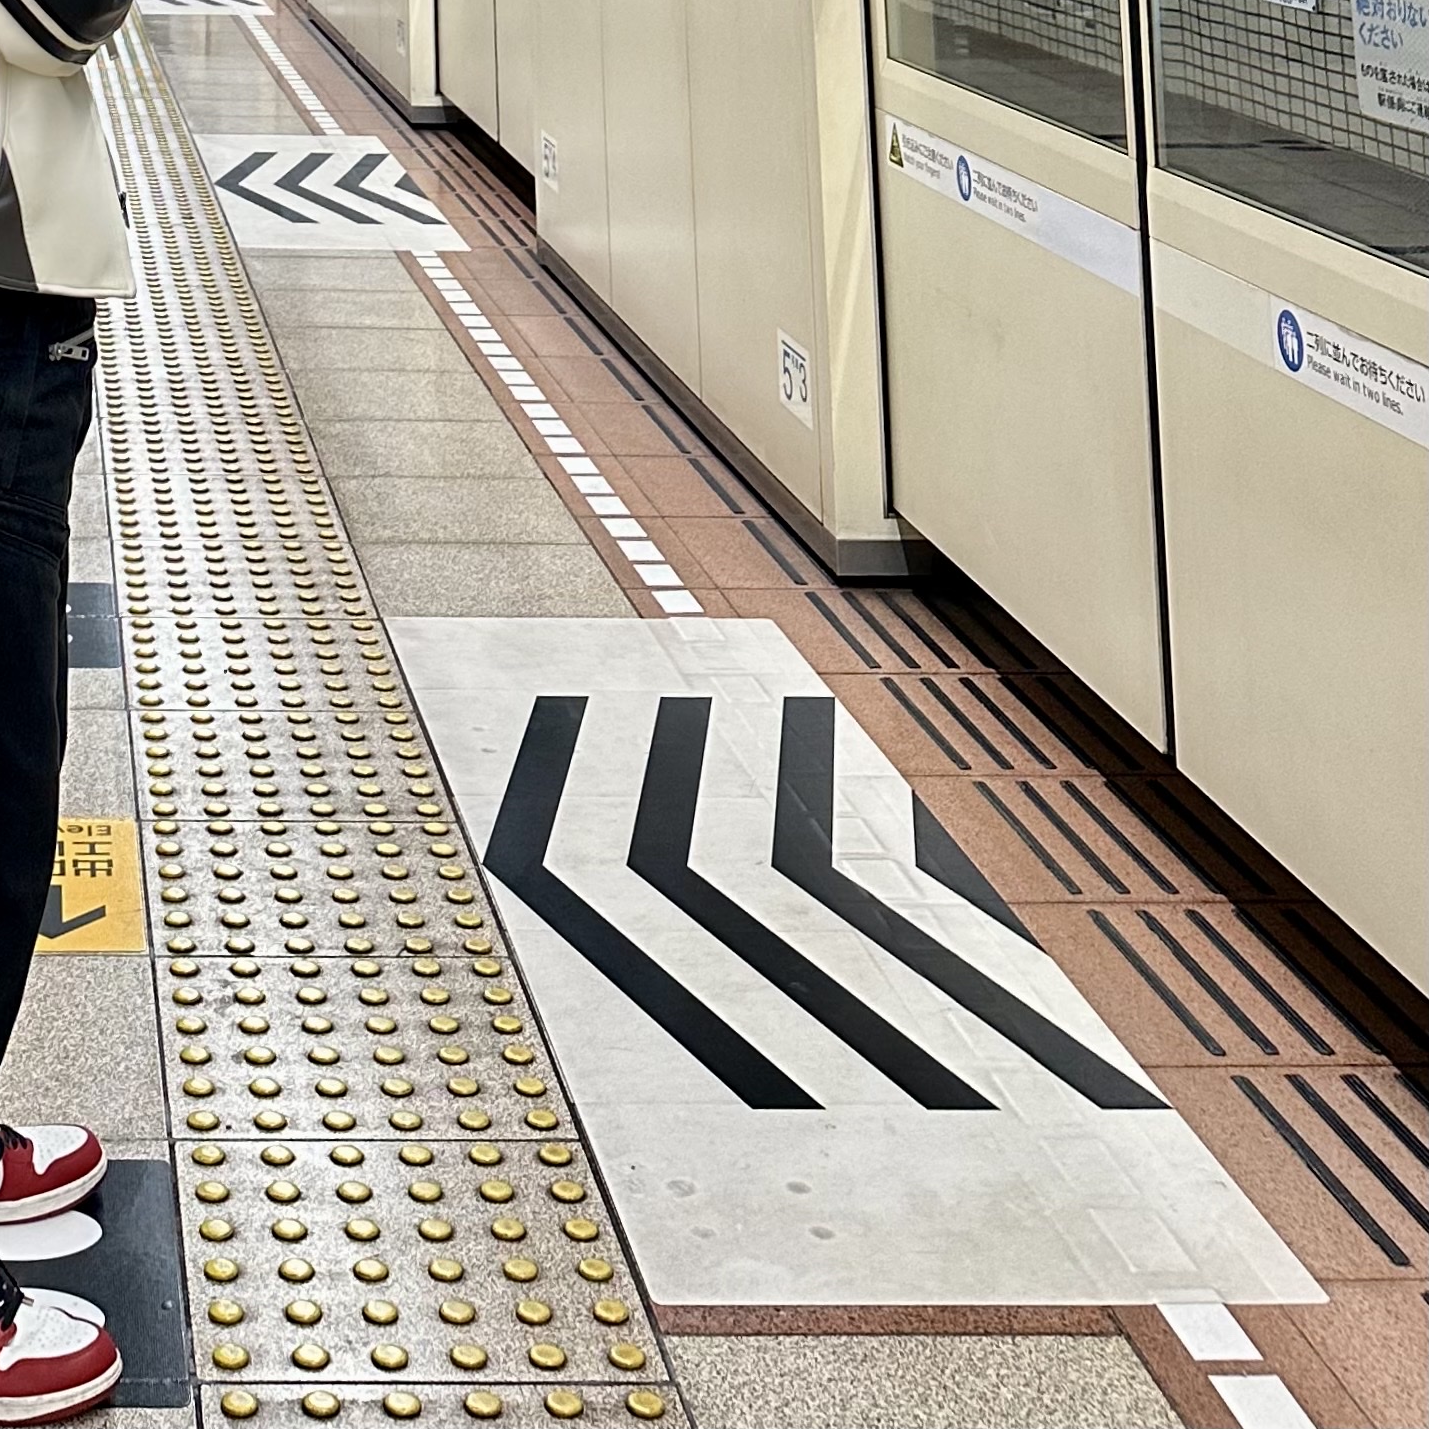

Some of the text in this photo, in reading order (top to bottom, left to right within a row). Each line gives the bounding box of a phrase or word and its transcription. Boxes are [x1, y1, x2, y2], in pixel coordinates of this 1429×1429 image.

[783, 348, 808, 403] 5 3
[1306, 331, 1426, 404] 二列に並んでお待ちください
[1307, 353, 1332, 379] Please
[1333, 370, 1351, 389] wait
[1352, 377, 1361, 394] in
[1363, 384, 1381, 404] two
